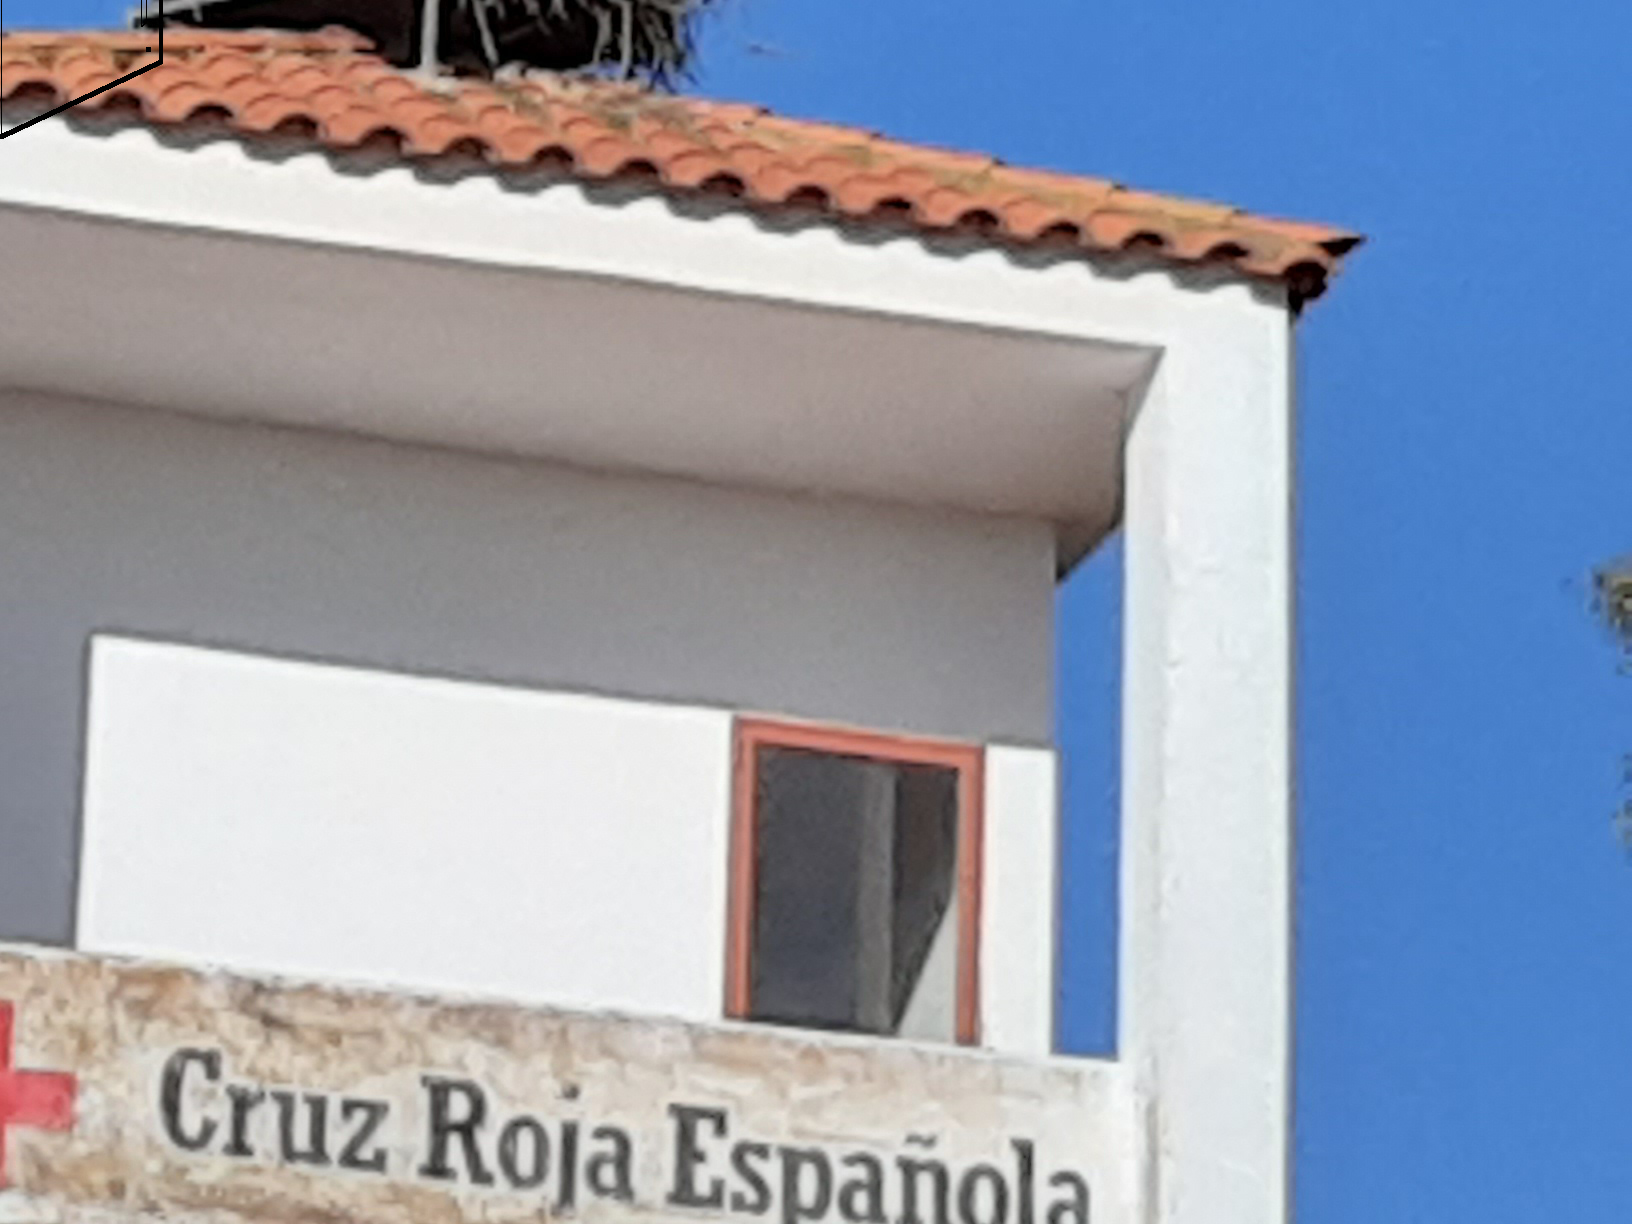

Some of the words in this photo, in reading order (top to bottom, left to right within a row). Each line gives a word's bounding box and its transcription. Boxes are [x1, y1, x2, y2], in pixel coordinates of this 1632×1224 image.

[159, 1048, 390, 1173] Cruz
[419, 1076, 636, 1216] Roja
[667, 1102, 1091, 1224] Española
